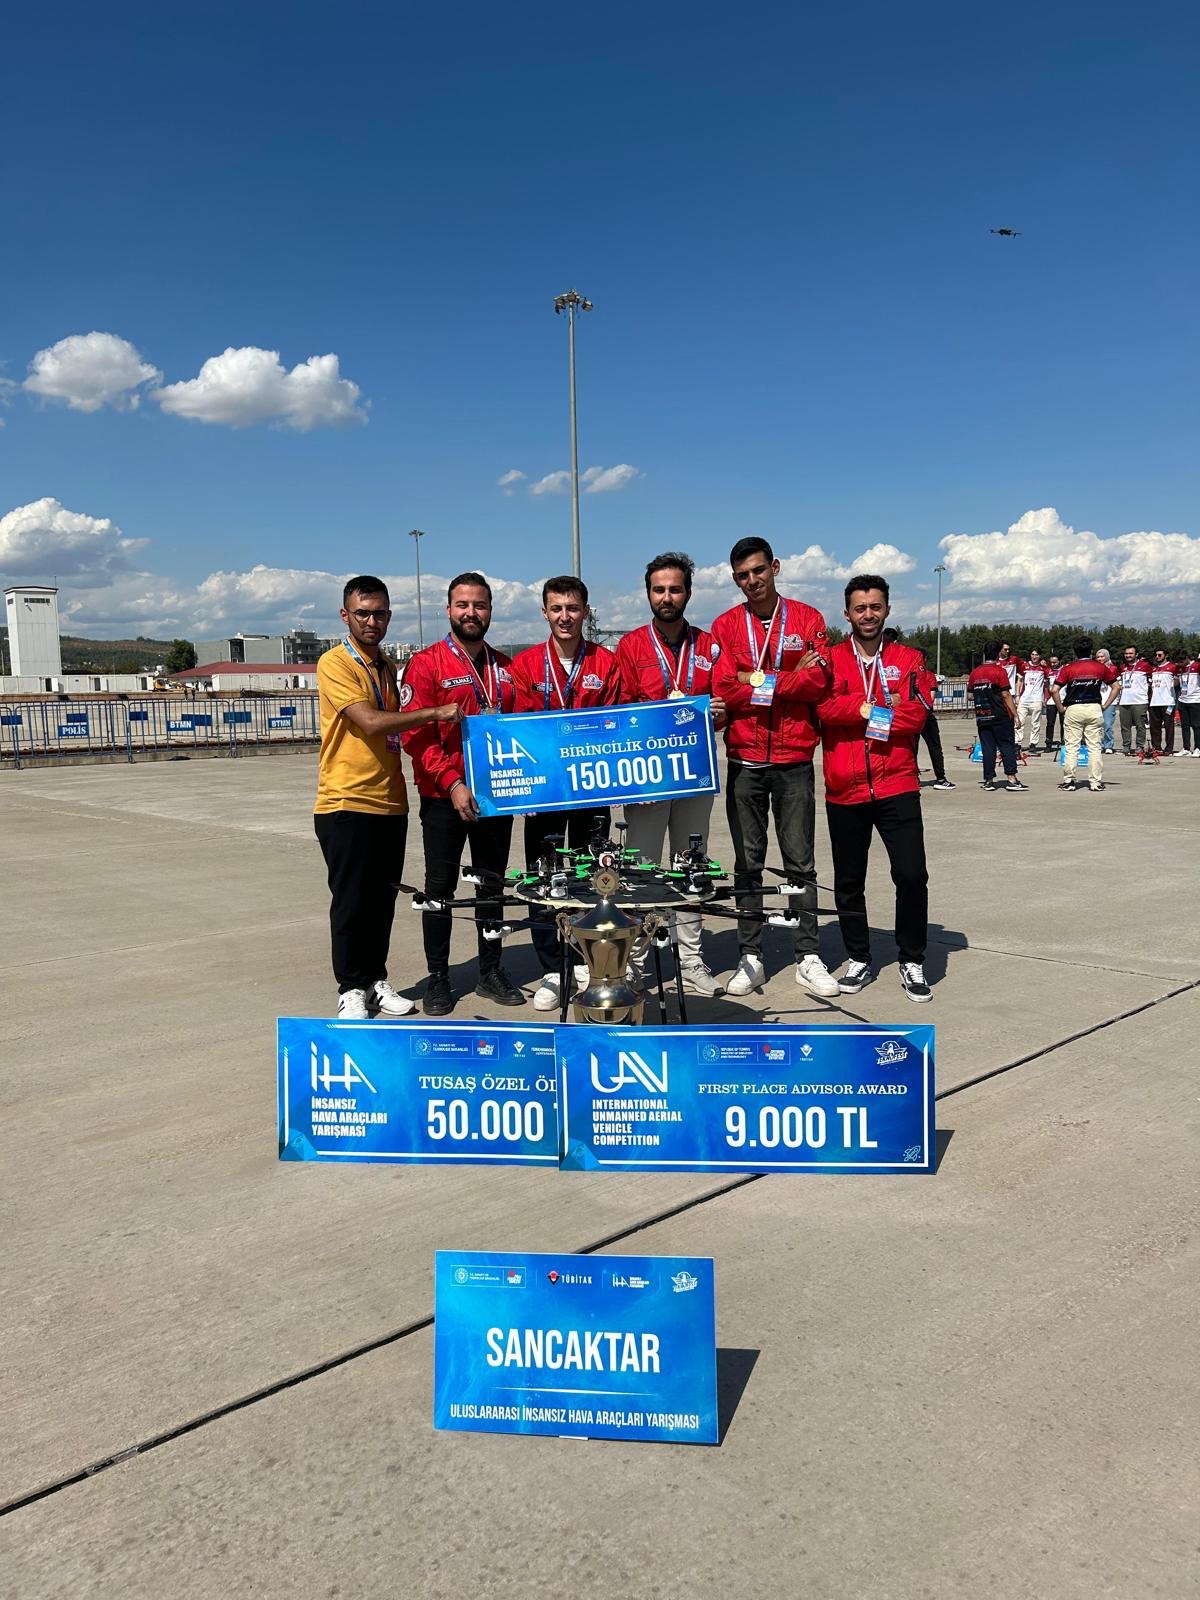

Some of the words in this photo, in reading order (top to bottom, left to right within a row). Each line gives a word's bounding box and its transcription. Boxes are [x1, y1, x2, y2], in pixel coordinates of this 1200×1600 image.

[169, 720, 192, 729] BTMN
[271, 719, 291, 728] BTMN
[62, 726, 87, 735] POLİS
[559, 741, 643, 759] BİRİNCİLİK
[645, 734, 699, 750] ÖDÜLÜ
[490, 768, 524, 779] İNSANSIZ
[566, 756, 663, 792] 150.000
[667, 753, 697, 783] TL
[491, 779, 511, 789] HAVA
[511, 776, 547, 788] ARAÇLARI
[491, 786, 532, 798] YARIŞMASI
[419, 1076, 477, 1093] TUSAŞ
[482, 1074, 530, 1091] ÖZEL
[698, 1084, 738, 1095] FIRST
[742, 1084, 788, 1095] PLACE
[791, 1084, 853, 1096] ADVISOR
[857, 1084, 908, 1096] AWARD
[311, 1096, 357, 1110] İNSANSIZ
[592, 1099, 669, 1110] INTERNATIONAL
[311, 1112, 338, 1123] HAVA
[339, 1113, 388, 1126] ARAÇLARI
[427, 1099, 544, 1142] 50.000
[592, 1111, 648, 1122] UNMANNED
[649, 1110, 683, 1122] AERIAL
[592, 1123, 633, 1134] VEHICLE
[725, 1105, 827, 1148] 9.000
[837, 1107, 878, 1148] TL
[593, 1134, 660, 1146] COMPETITION
[561, 1274, 592, 1284] TÜBİTAK
[486, 1327, 660, 1373] SANCAKTAR
[450, 1404, 520, 1421] ULUSLARARASI
[522, 1405, 566, 1423] İNSANSIZ
[568, 1409, 594, 1424] HAVA
[596, 1411, 643, 1428] ARAÇLARI
[646, 1414, 699, 1431] YARIŞMASI
